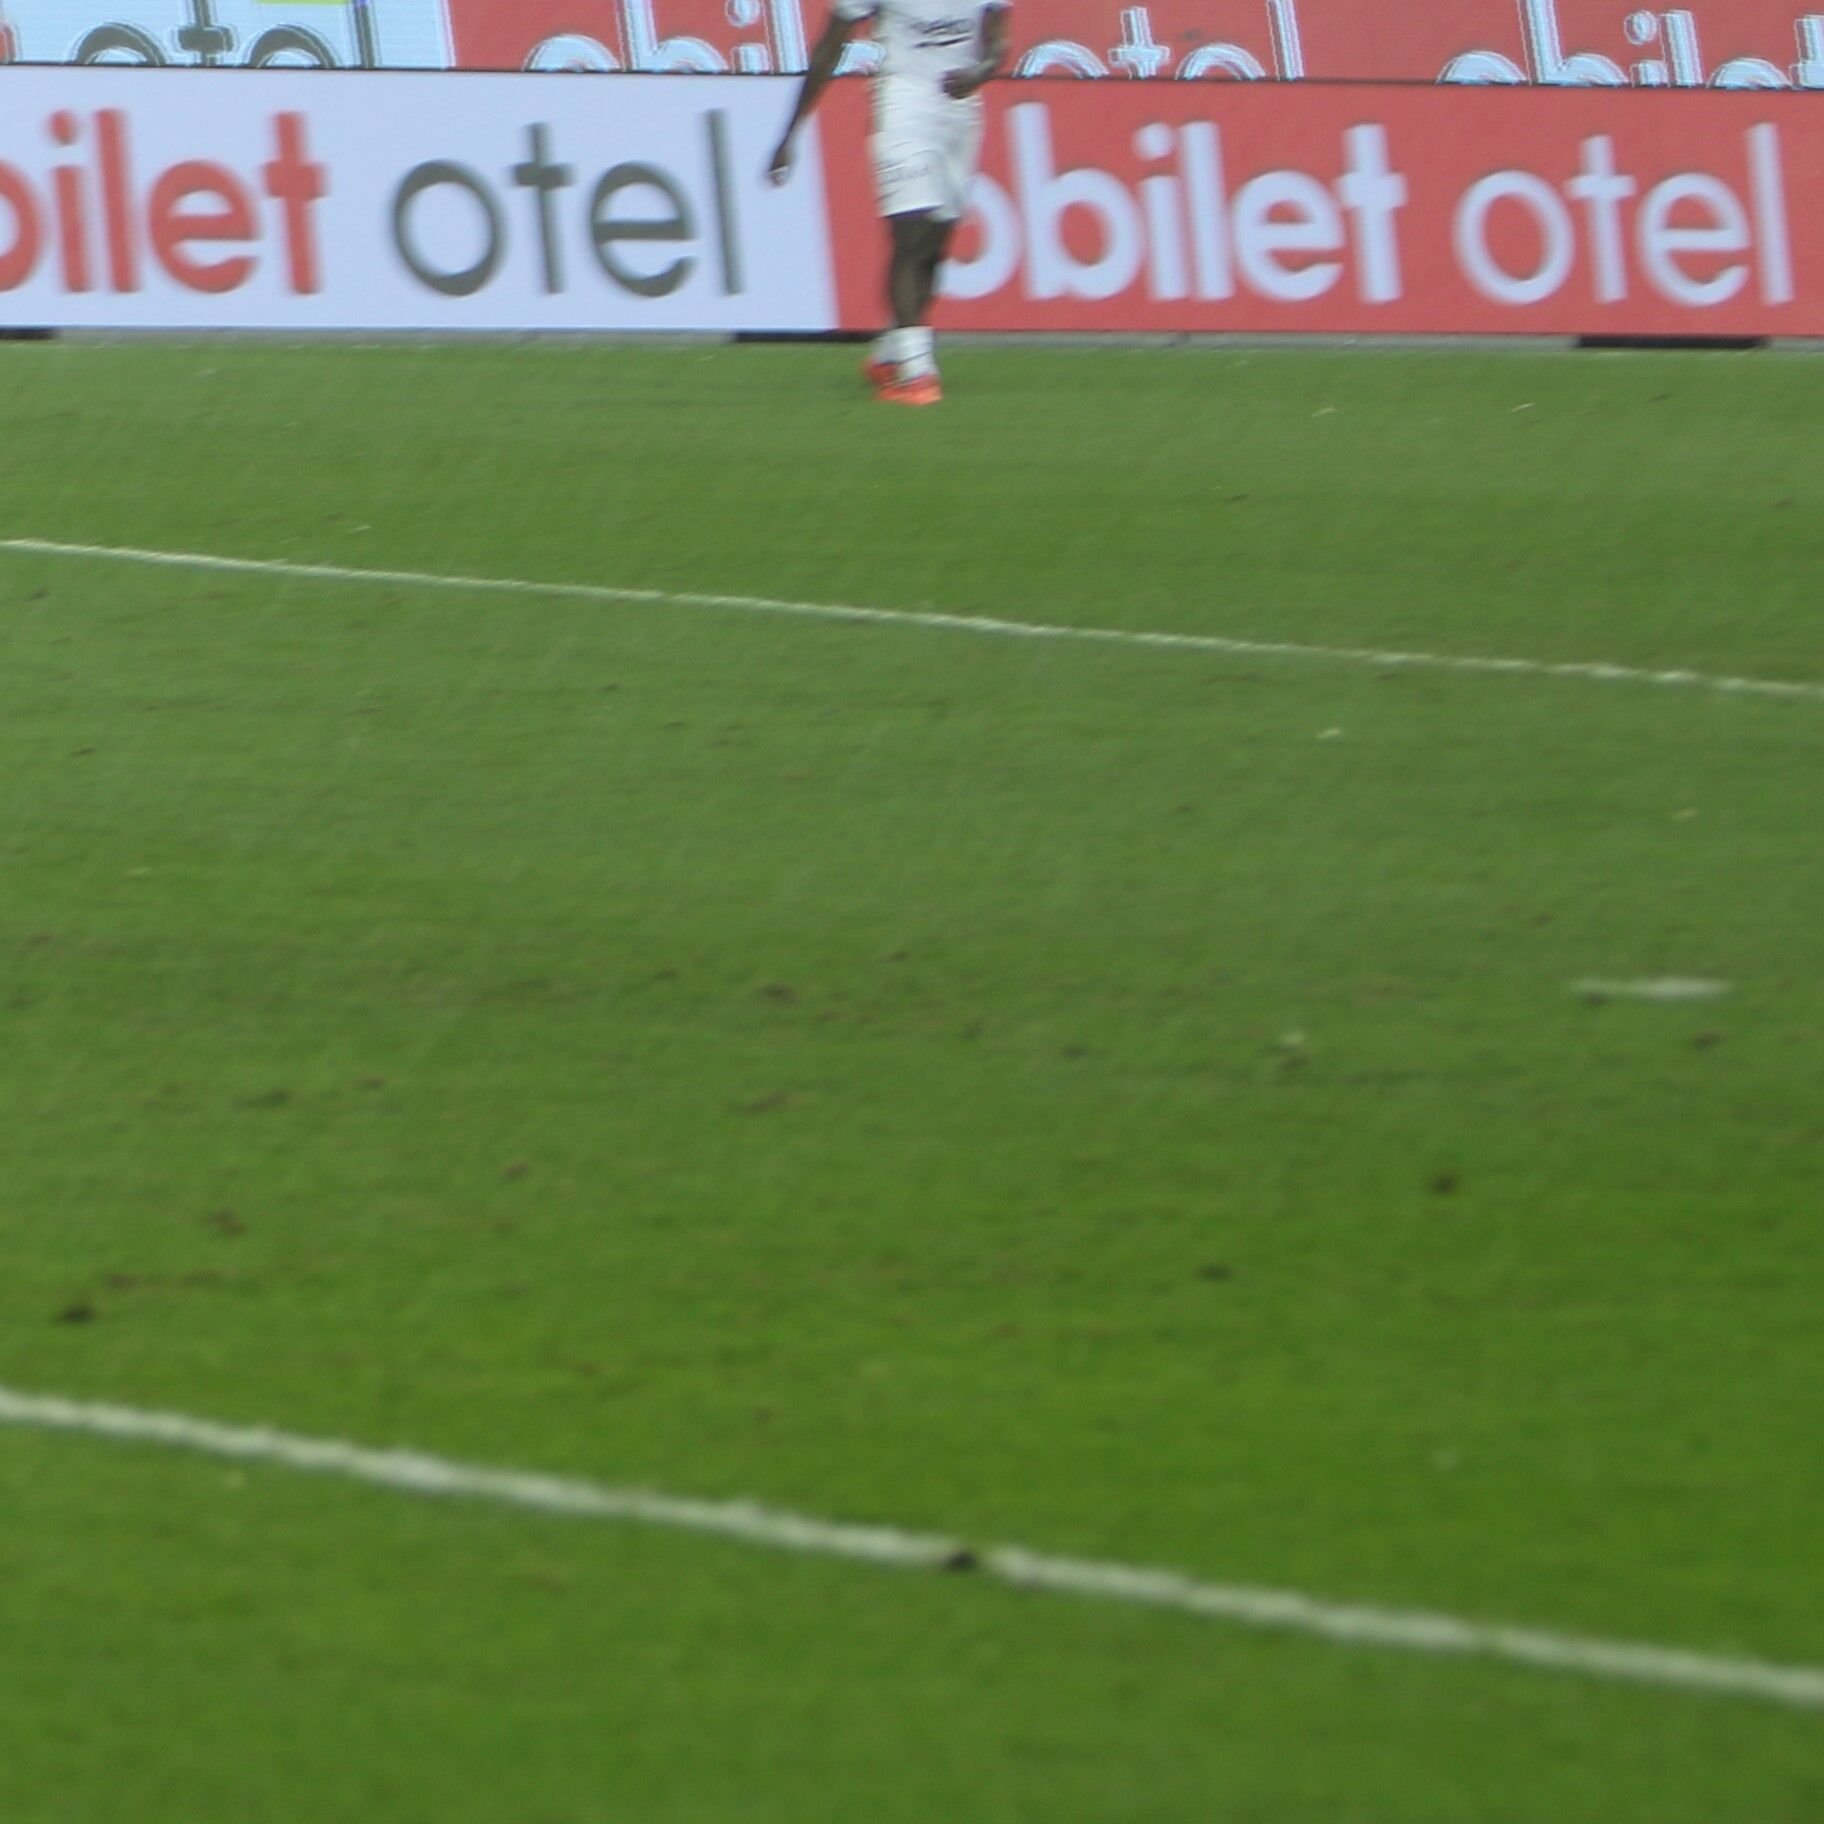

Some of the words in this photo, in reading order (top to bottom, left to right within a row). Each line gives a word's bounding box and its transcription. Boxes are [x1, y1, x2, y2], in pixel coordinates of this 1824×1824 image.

[388, 108, 746, 300] otel
[934, 102, 1408, 305] obilet
[1454, 121, 1794, 310] otel
